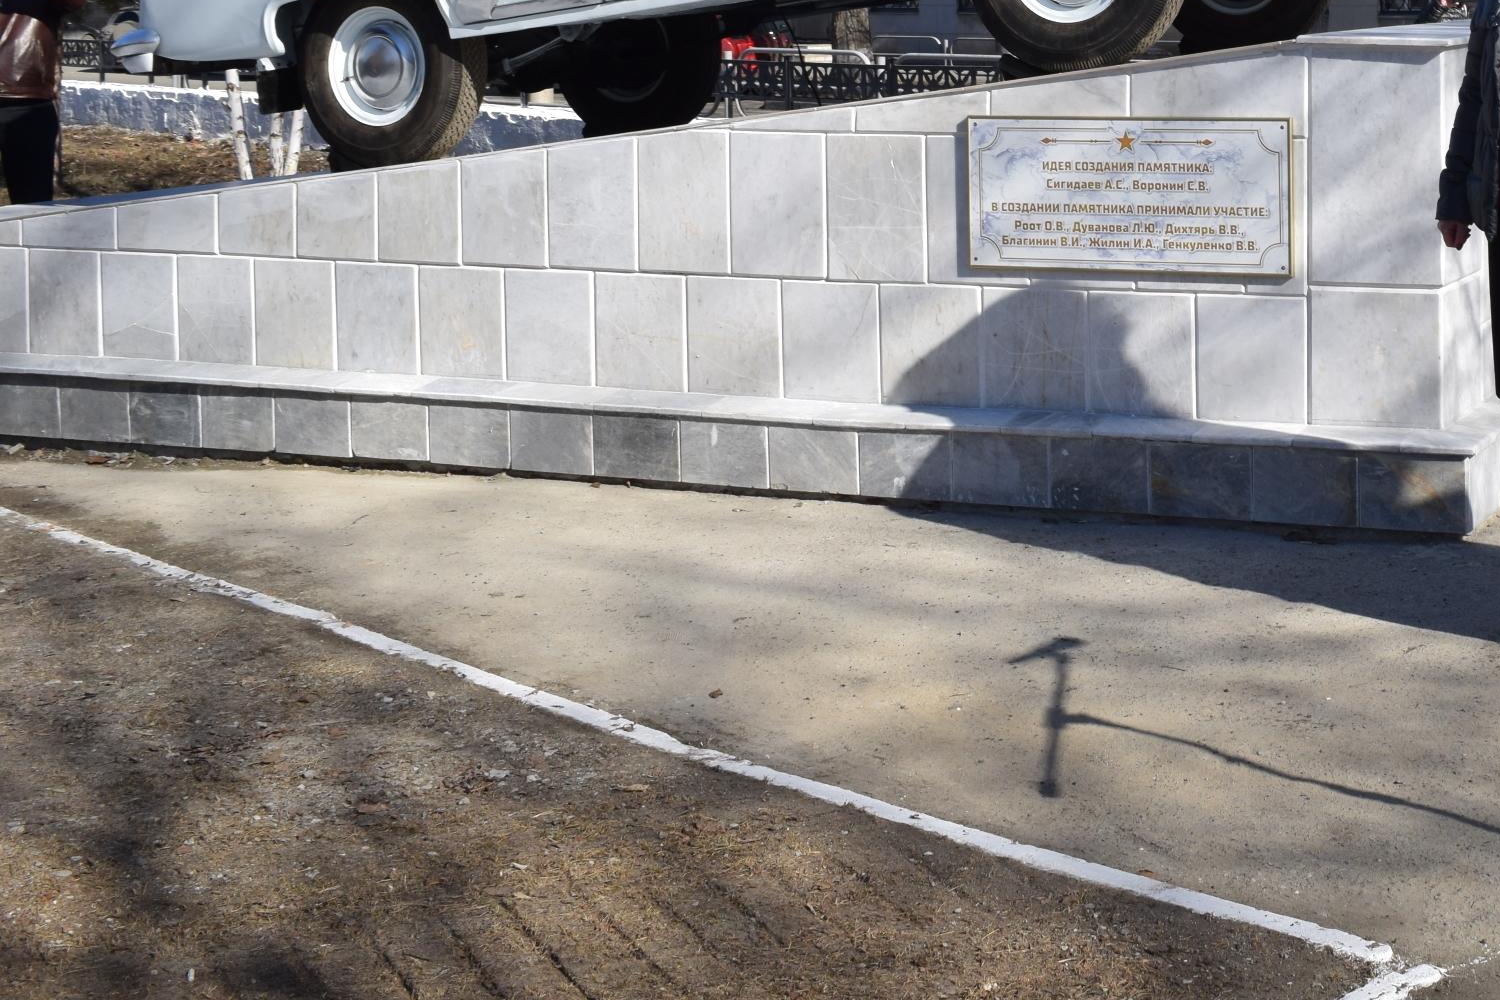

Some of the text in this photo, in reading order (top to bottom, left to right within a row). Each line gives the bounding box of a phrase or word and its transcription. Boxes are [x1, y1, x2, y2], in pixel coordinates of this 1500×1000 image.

[1042, 161, 1213, 173] ИДЕЯ СОЗДАНИЯ ПАМЯТНИКА:
[1046, 178, 1209, 192] Сигидаев А.С., Воронин С.В.
[991, 202, 1269, 217] В СОЗДАНИИ ПАМЯТНИКА ПРИНИМАЛИ УЧАСТИЕ:
[1014, 220, 1244, 236] Роот О.В., Дуванова Л.Ю., Дихтярь В.В.,
[1002, 235, 1258, 251] Благинин В.И., Жилин И.А., Генкуленко В.В.
